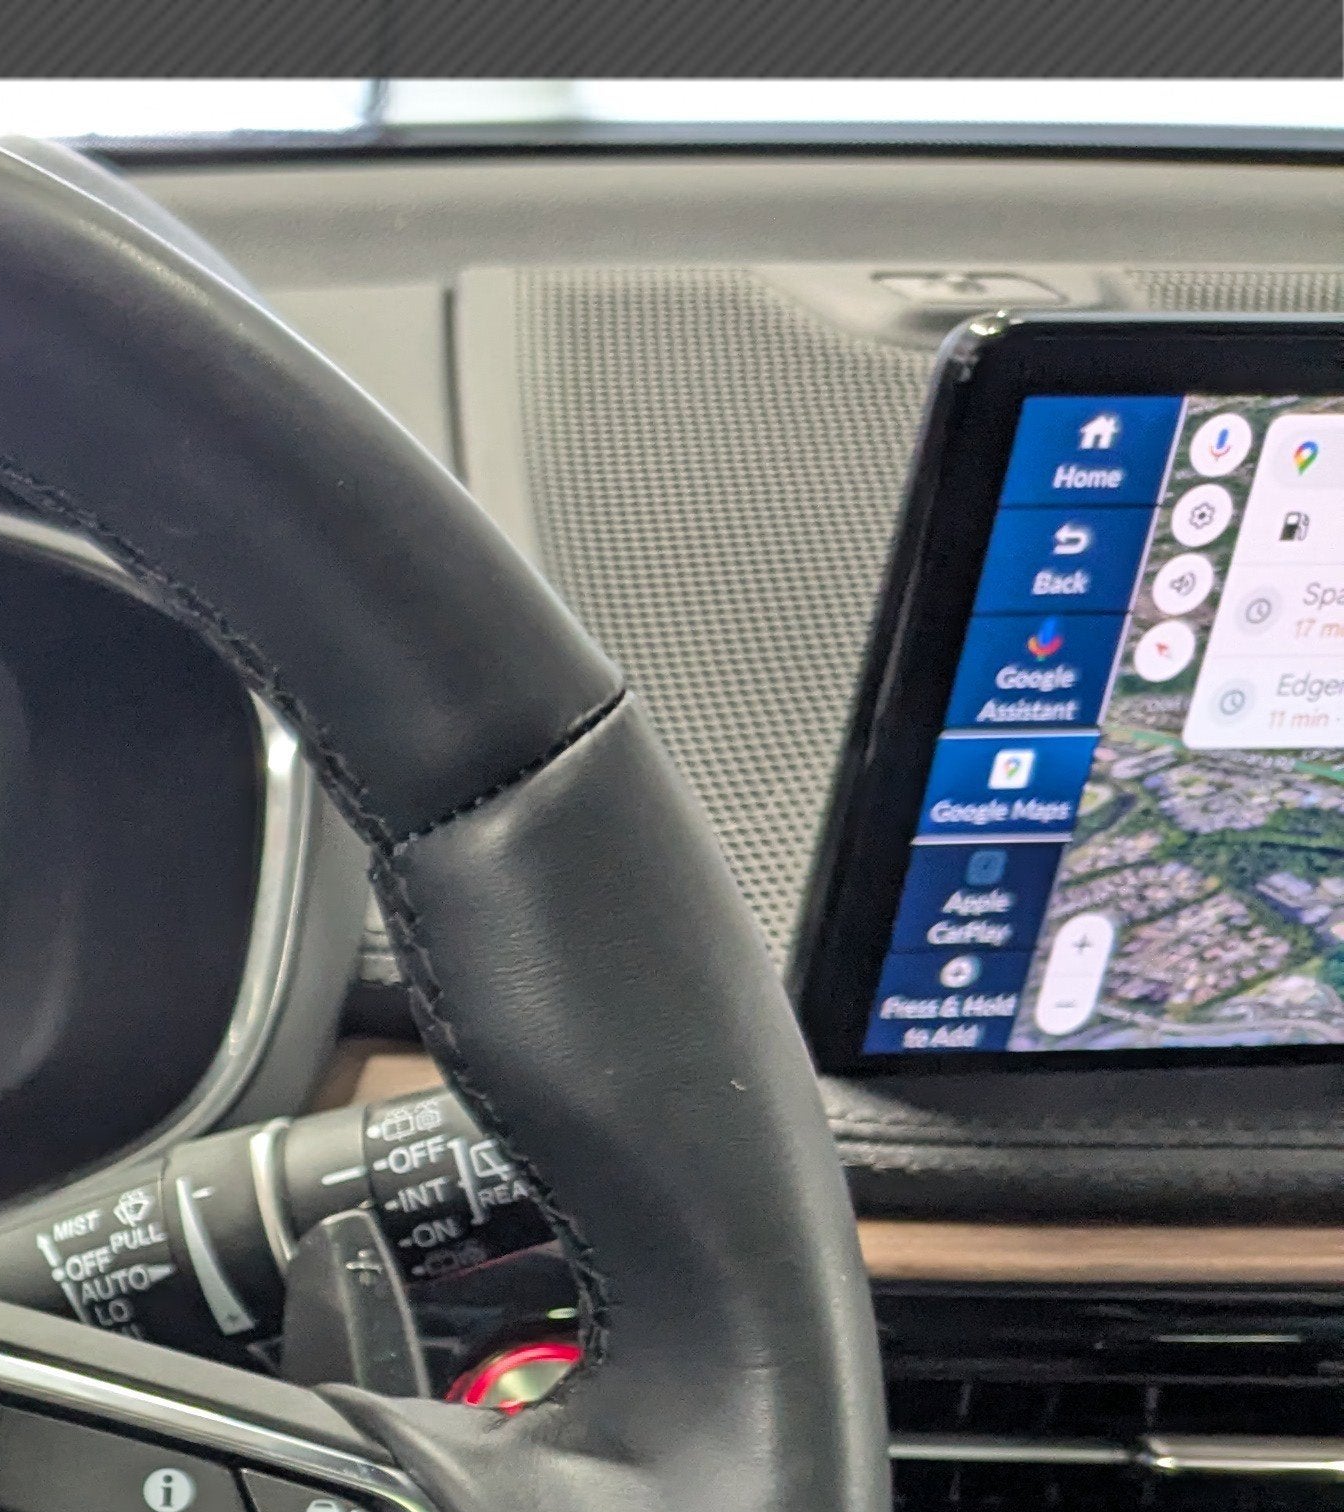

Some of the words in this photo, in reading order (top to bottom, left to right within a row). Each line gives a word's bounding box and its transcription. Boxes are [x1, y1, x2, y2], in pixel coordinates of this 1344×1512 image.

[1052, 463, 1124, 490] Home
[1031, 569, 1090, 595] Back
[995, 664, 1078, 692] Google
[976, 699, 1080, 723] Assistant
[1290, 708, 1330, 729] min
[930, 798, 1009, 825] Google
[1011, 798, 1071, 824] Maps
[942, 889, 1014, 915] Apple
[927, 920, 1014, 947] CarPlay
[879, 995, 938, 1020] Press
[961, 993, 1017, 1018] Hold
[388, 1134, 450, 1175] OFF
[399, 1175, 451, 1213] INT
[53, 1208, 102, 1243] MIST
[110, 1221, 169, 1254] PULL
[413, 1218, 461, 1248] ON
[65, 1245, 113, 1282] OFF
[82, 1263, 150, 1306] AUTO
[95, 1297, 134, 1327] LO
